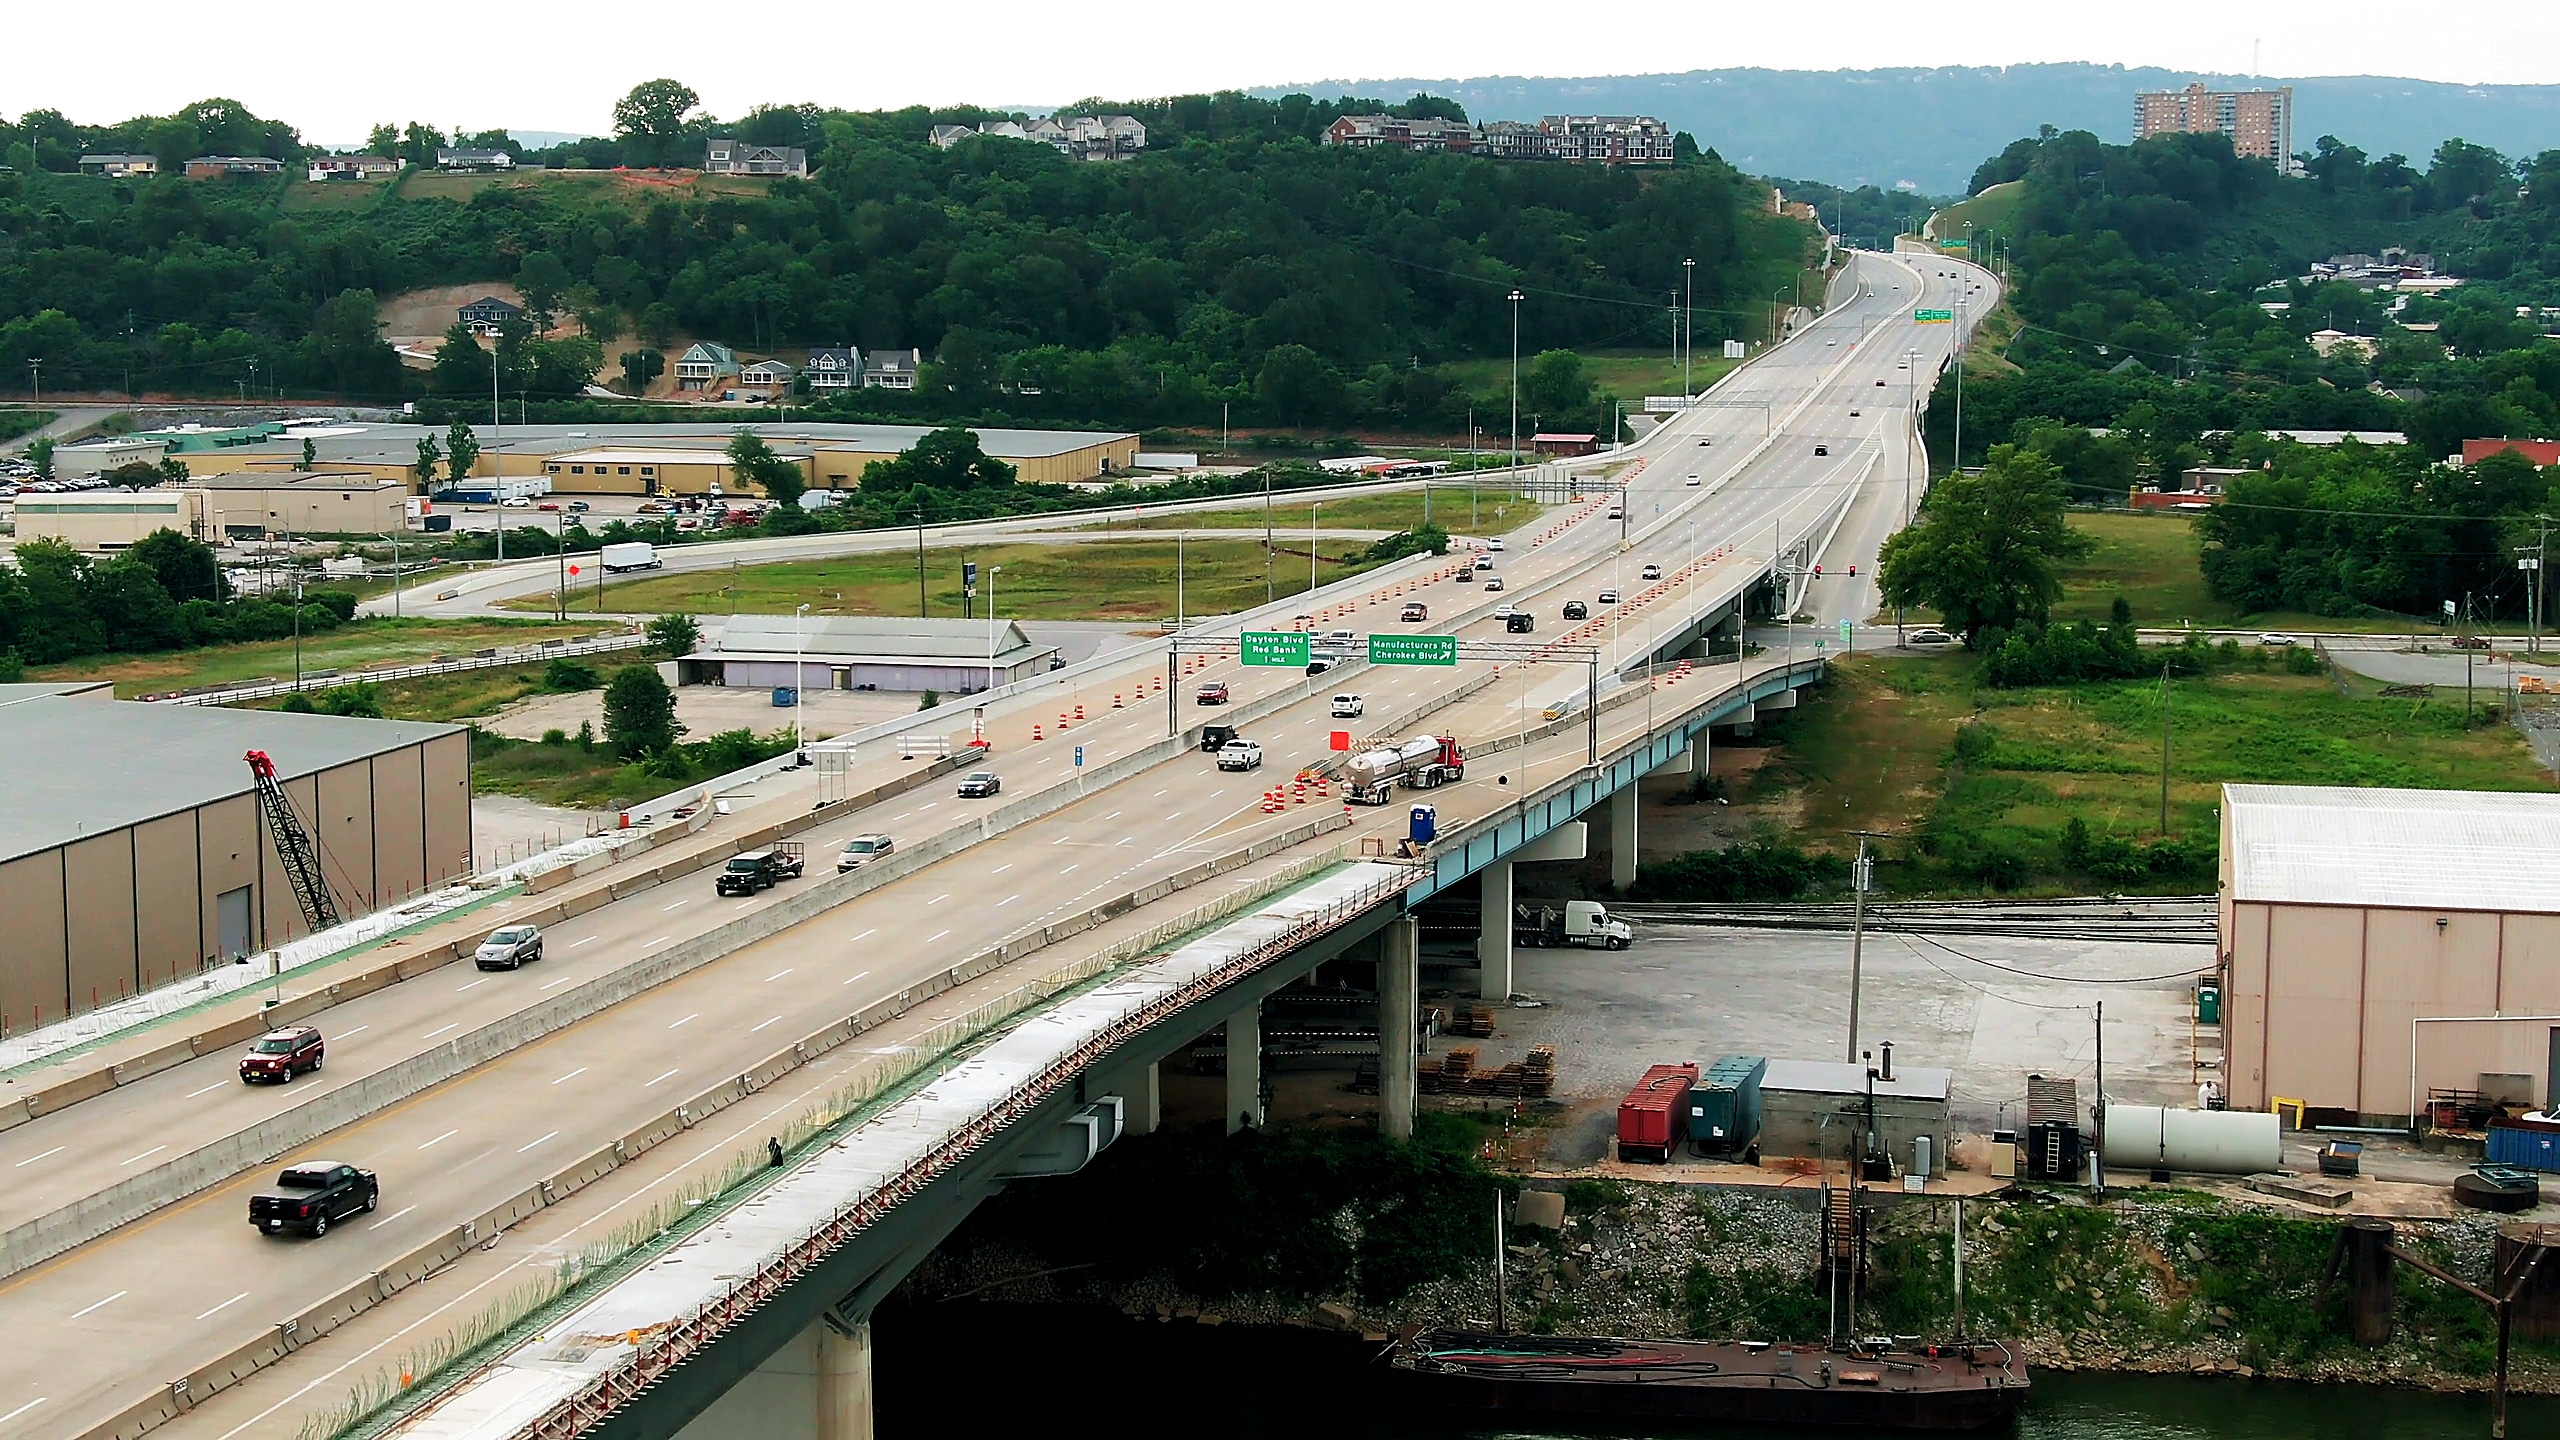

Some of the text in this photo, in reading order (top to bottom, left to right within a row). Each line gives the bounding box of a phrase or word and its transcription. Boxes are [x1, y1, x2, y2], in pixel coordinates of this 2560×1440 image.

[1245, 635, 1303, 645] Dayton Blvd
[1252, 645, 1297, 654] Red Bank
[1373, 641, 1453, 650] Manufacturers Rd
[1376, 651, 1438, 660] Cherokee Blvd
